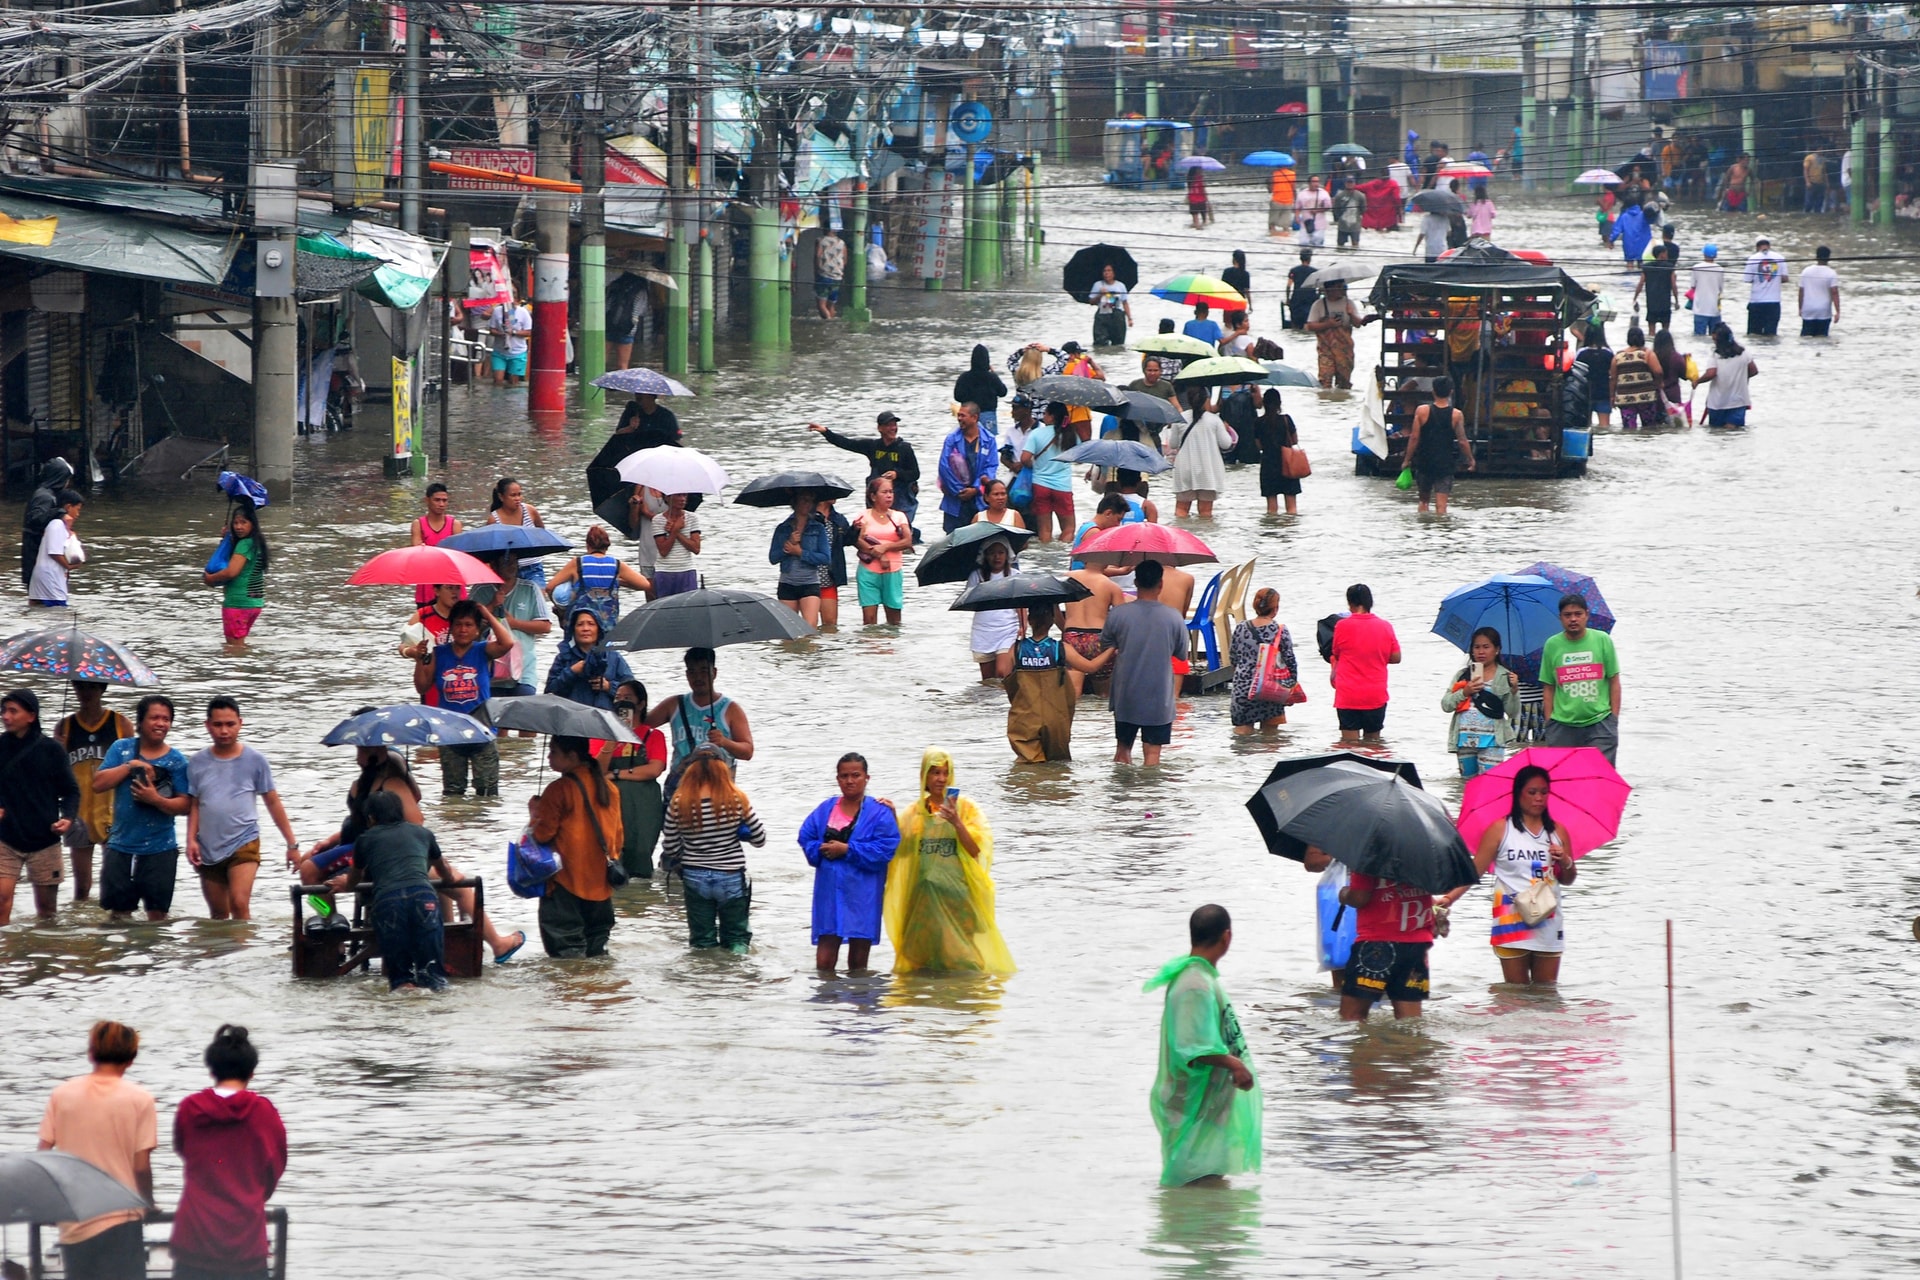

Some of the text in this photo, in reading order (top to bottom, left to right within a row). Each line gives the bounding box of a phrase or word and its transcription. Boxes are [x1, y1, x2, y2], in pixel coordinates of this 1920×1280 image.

[452, 152, 531, 174] SOUNDPRO
[451, 177, 528, 191] ELECTRONICS
[1507, 849, 1547, 861] GAME
